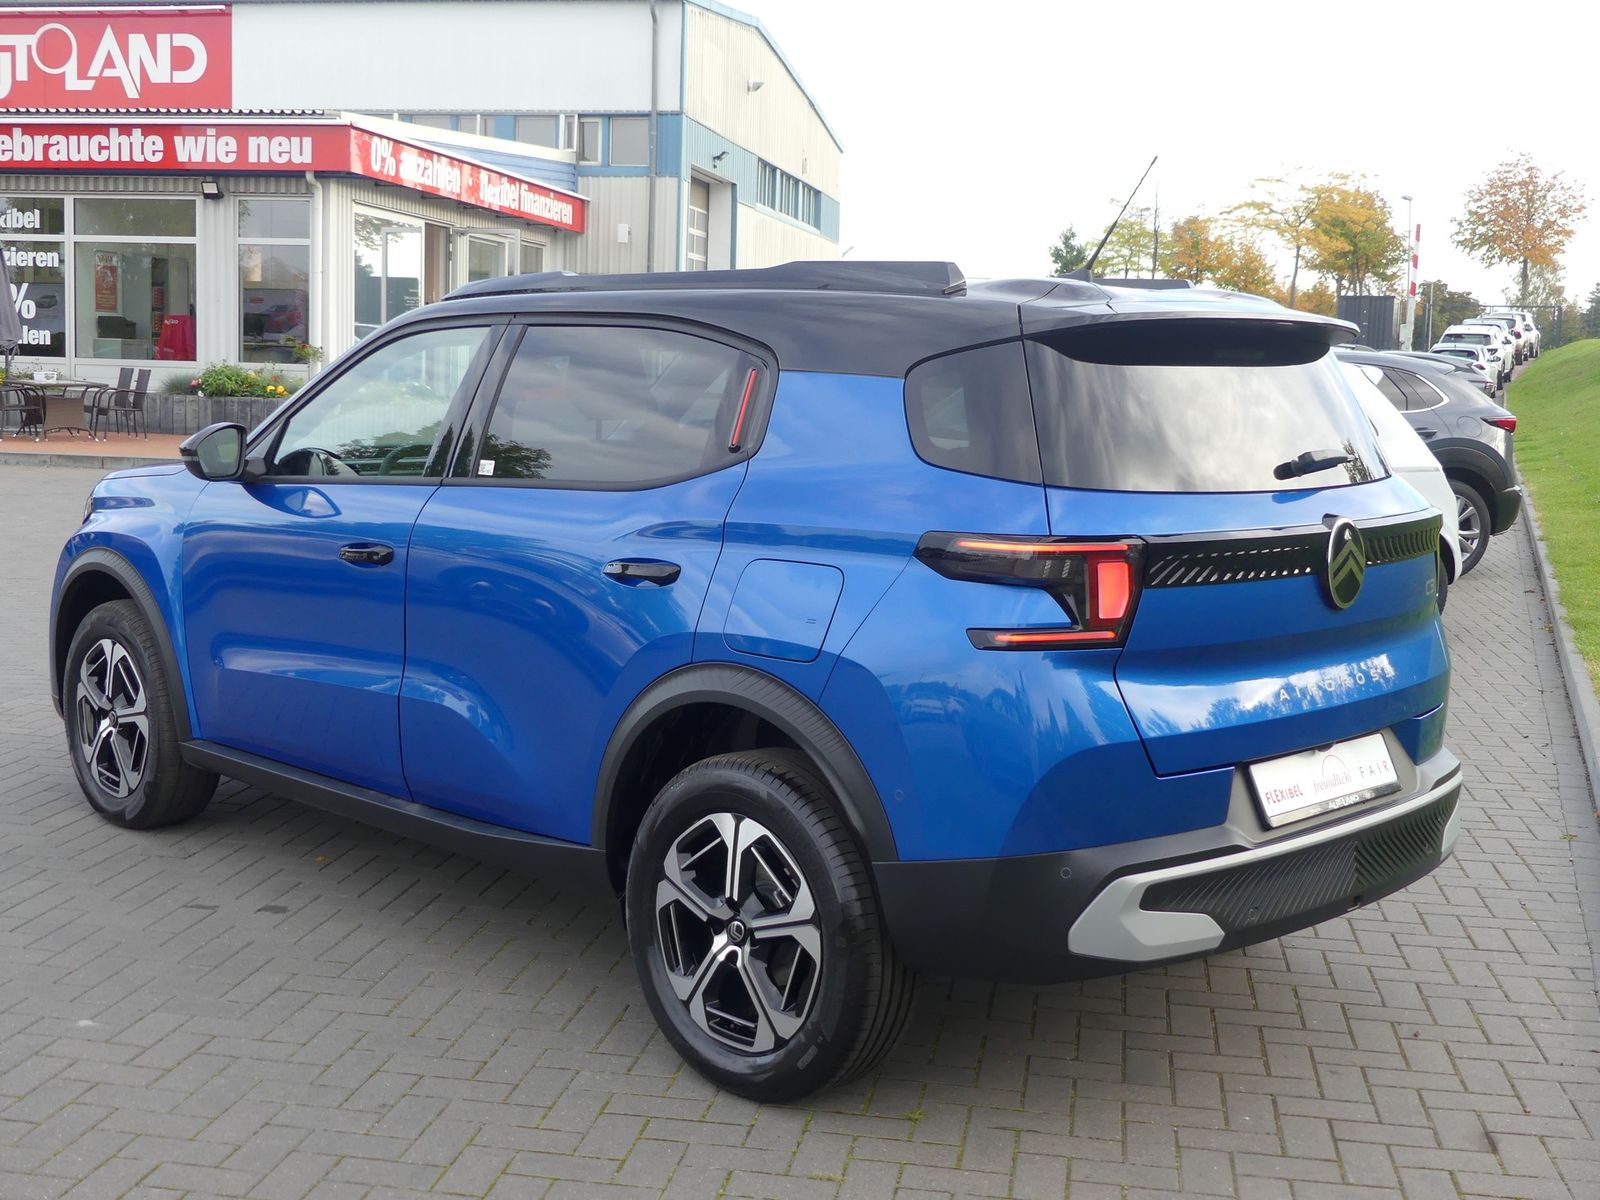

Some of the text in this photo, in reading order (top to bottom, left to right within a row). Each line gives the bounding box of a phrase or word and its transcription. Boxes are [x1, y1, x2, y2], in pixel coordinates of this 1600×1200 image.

[174, 128, 237, 163] wie
[248, 135, 312, 164] neu
[370, 135, 573, 225] 0% anzahlen flexibel finanzieren
[17, 325, 51, 345] len
[1264, 783, 1304, 806] FLEXIBEL
